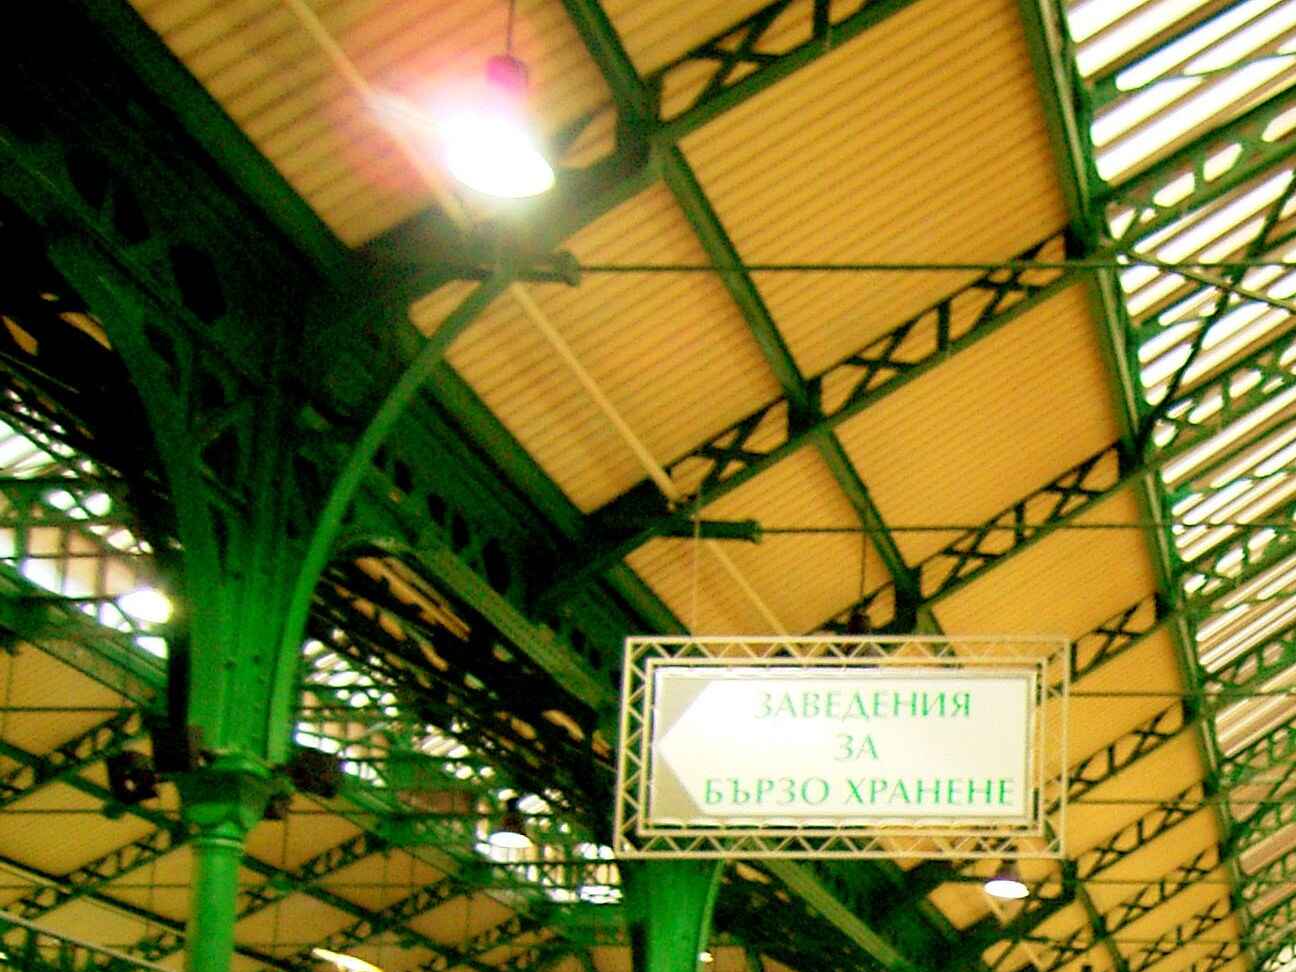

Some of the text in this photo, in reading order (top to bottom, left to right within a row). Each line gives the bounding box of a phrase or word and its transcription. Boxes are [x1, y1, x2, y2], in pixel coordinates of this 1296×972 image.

[754, 691, 971, 721] ЗАВЕДЕНИЯ
[833, 733, 879, 762] ЗА
[704, 775, 1015, 806] БЪРЗО ХРАНЕНЕ
